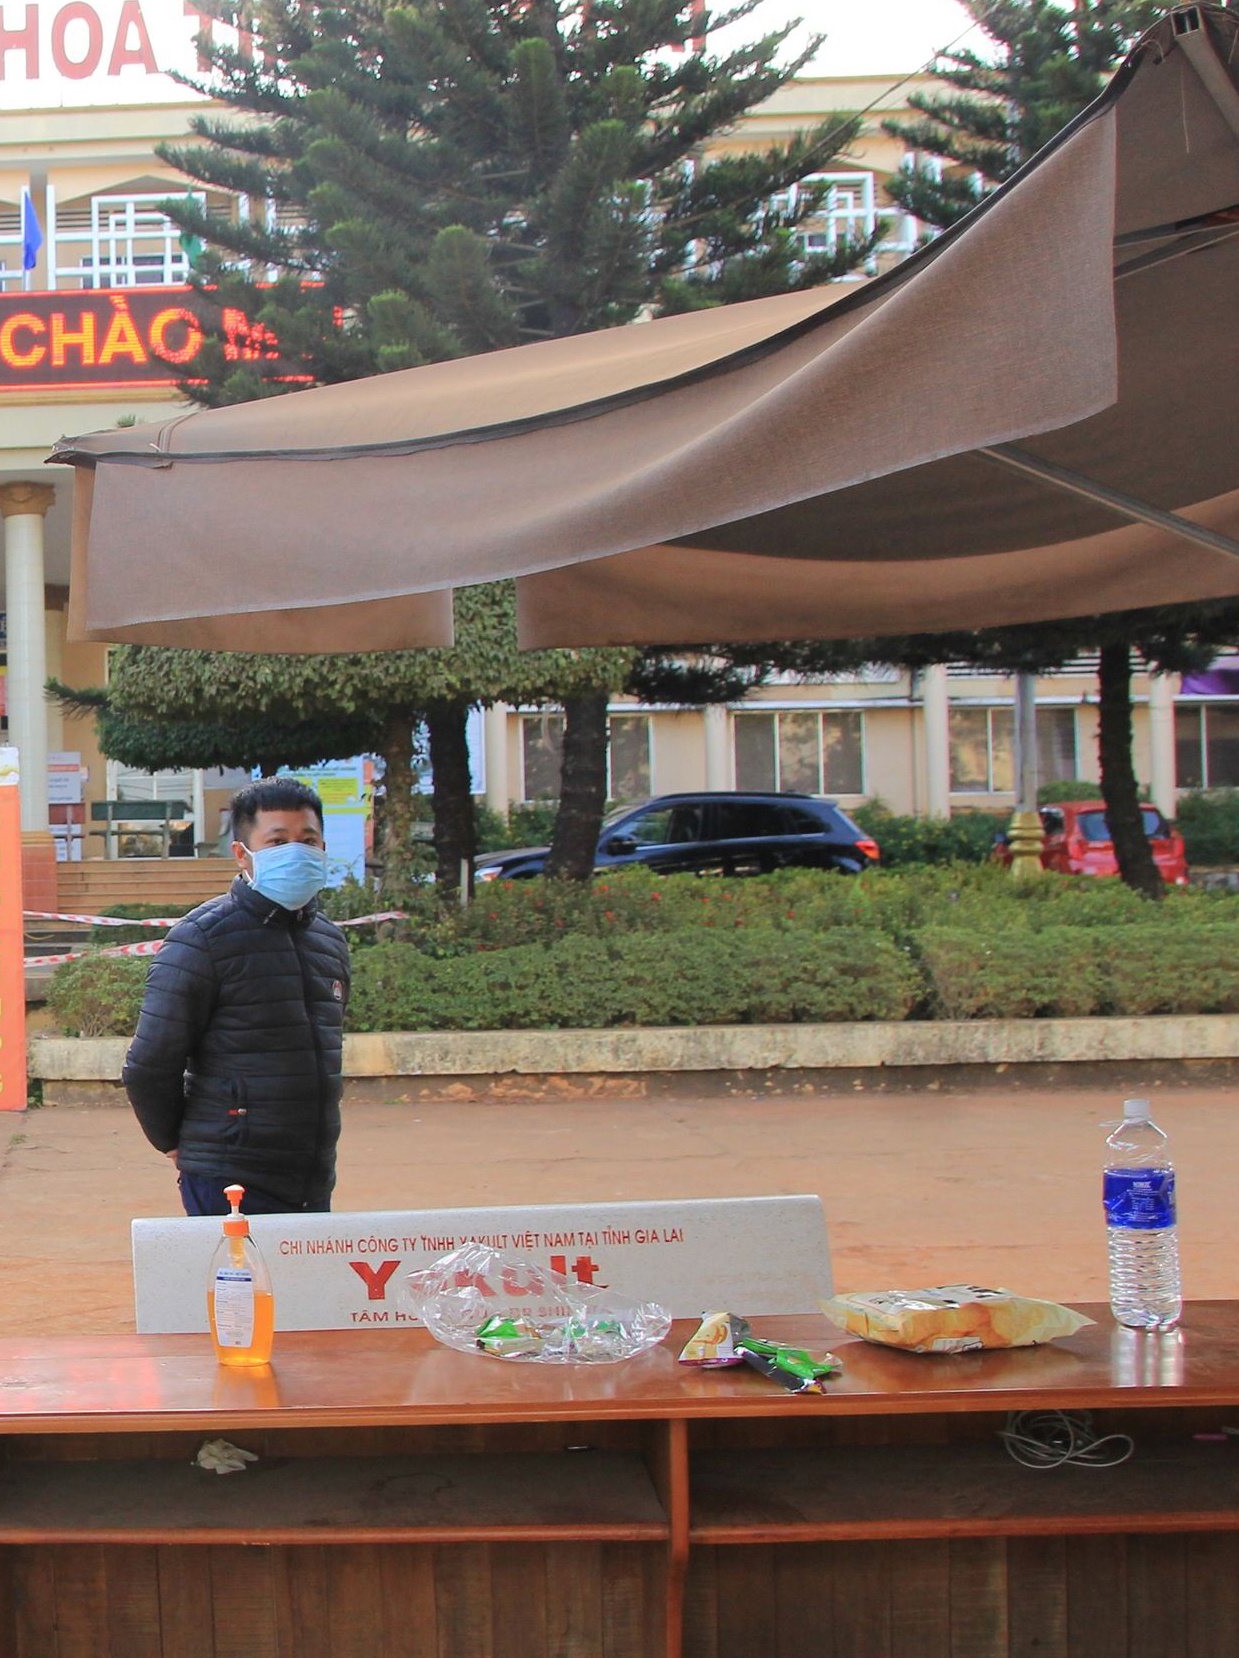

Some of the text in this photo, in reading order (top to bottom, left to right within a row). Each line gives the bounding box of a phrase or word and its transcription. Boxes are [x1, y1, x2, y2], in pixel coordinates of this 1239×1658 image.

[280, 1240, 302, 1255] CHI
[307, 1236, 353, 1254] NHÁNH
[357, 1235, 398, 1253] CÔNG
[403, 1237, 416, 1252] TY
[511, 1231, 539, 1251] VIỆT
[544, 1233, 575, 1247] NAM
[579, 1231, 598, 1249] TẠI
[602, 1225, 630, 1245] TỈNH
[635, 1229, 659, 1244] GIA
[663, 1228, 684, 1243] LAI
[350, 1310, 389, 1322] TÂM
